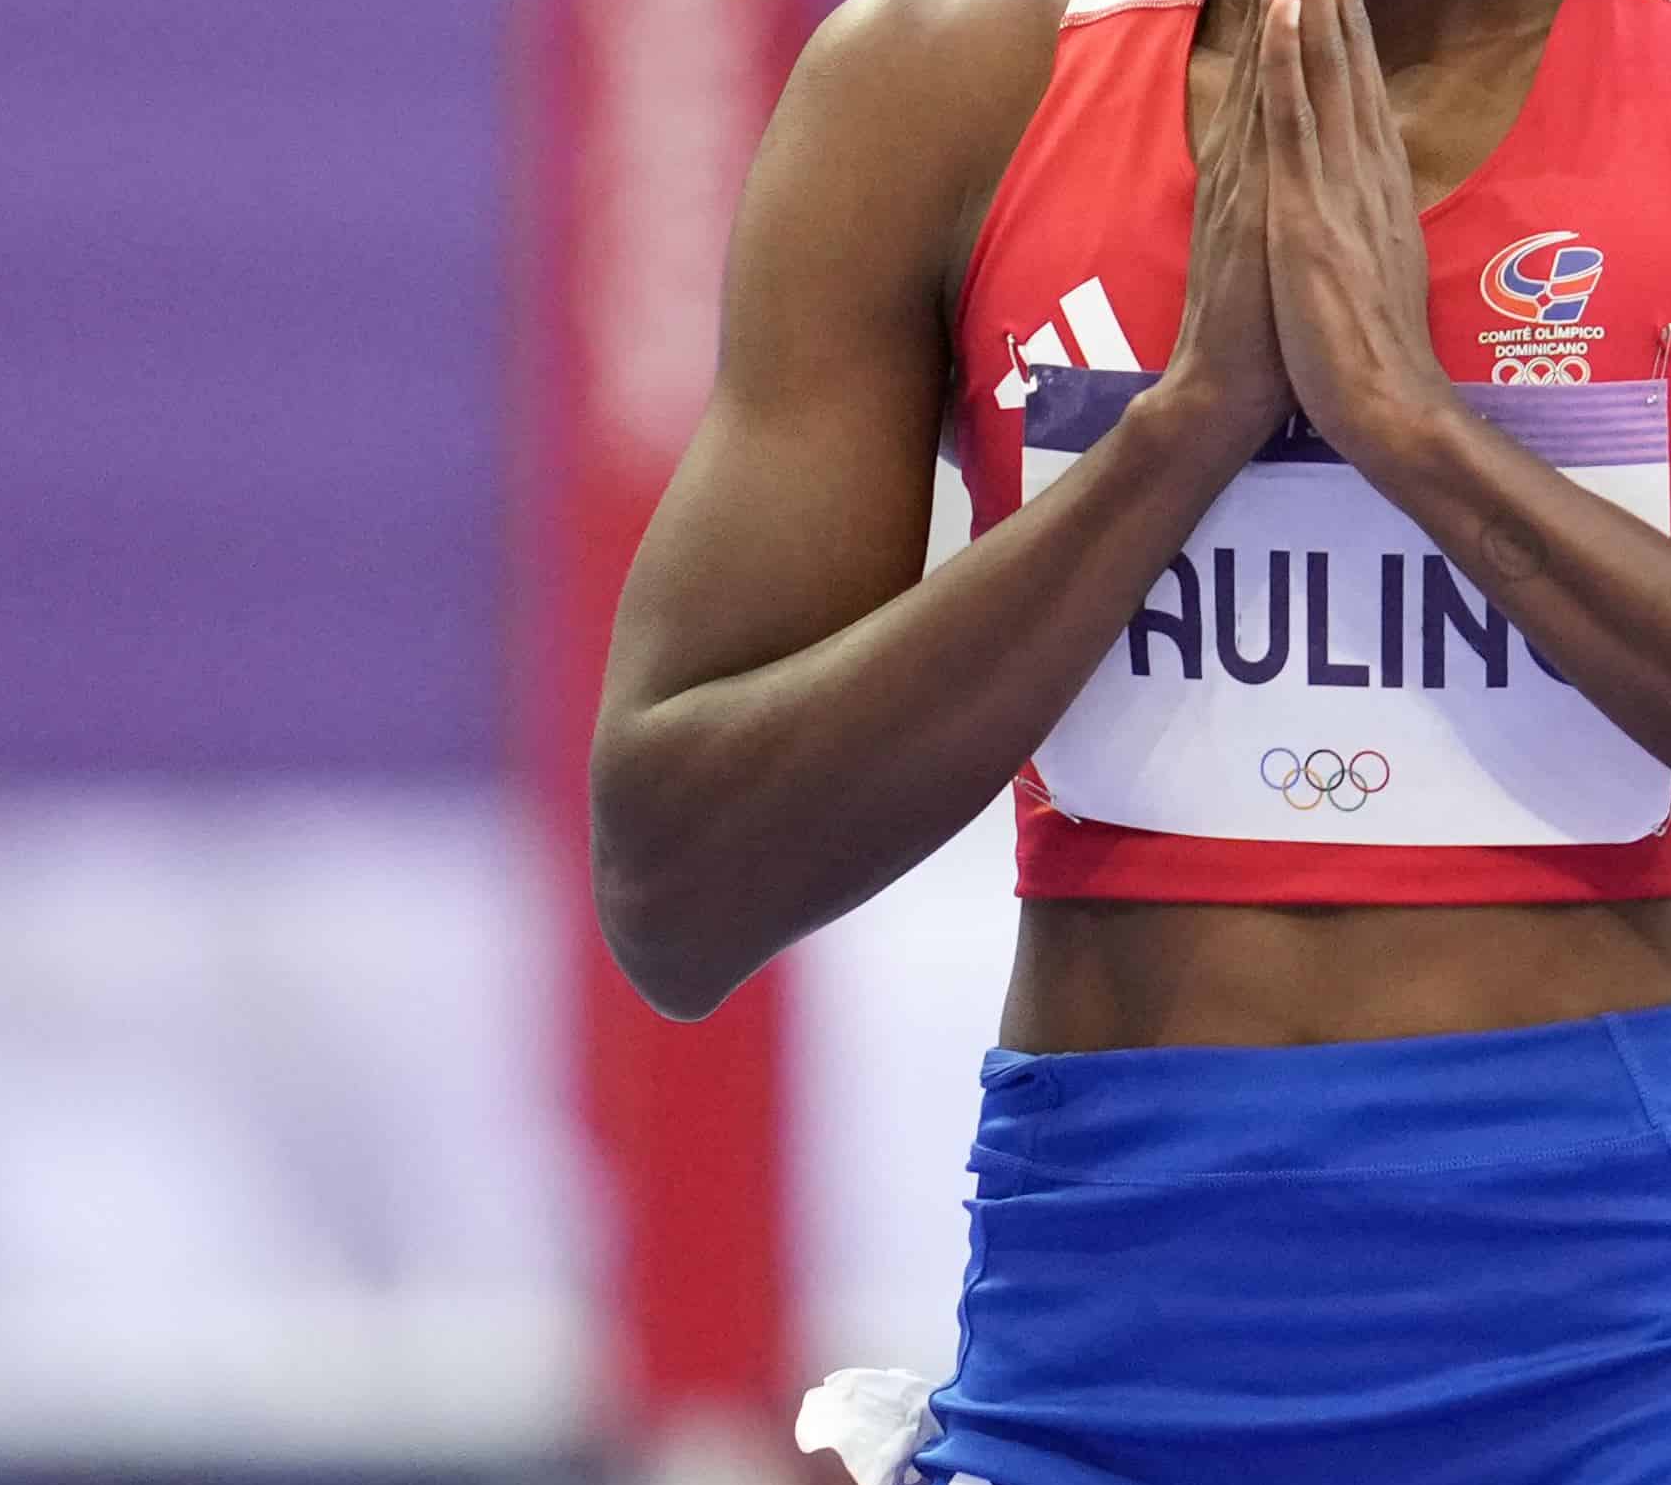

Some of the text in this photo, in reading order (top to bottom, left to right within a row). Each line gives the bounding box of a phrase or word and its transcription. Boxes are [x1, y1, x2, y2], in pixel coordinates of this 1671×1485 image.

[1479, 324, 1606, 344] COMITÉ OLÍMPICO
[1494, 342, 1589, 358] DOMINICANO
[1129, 548, 1577, 689] AULIN
